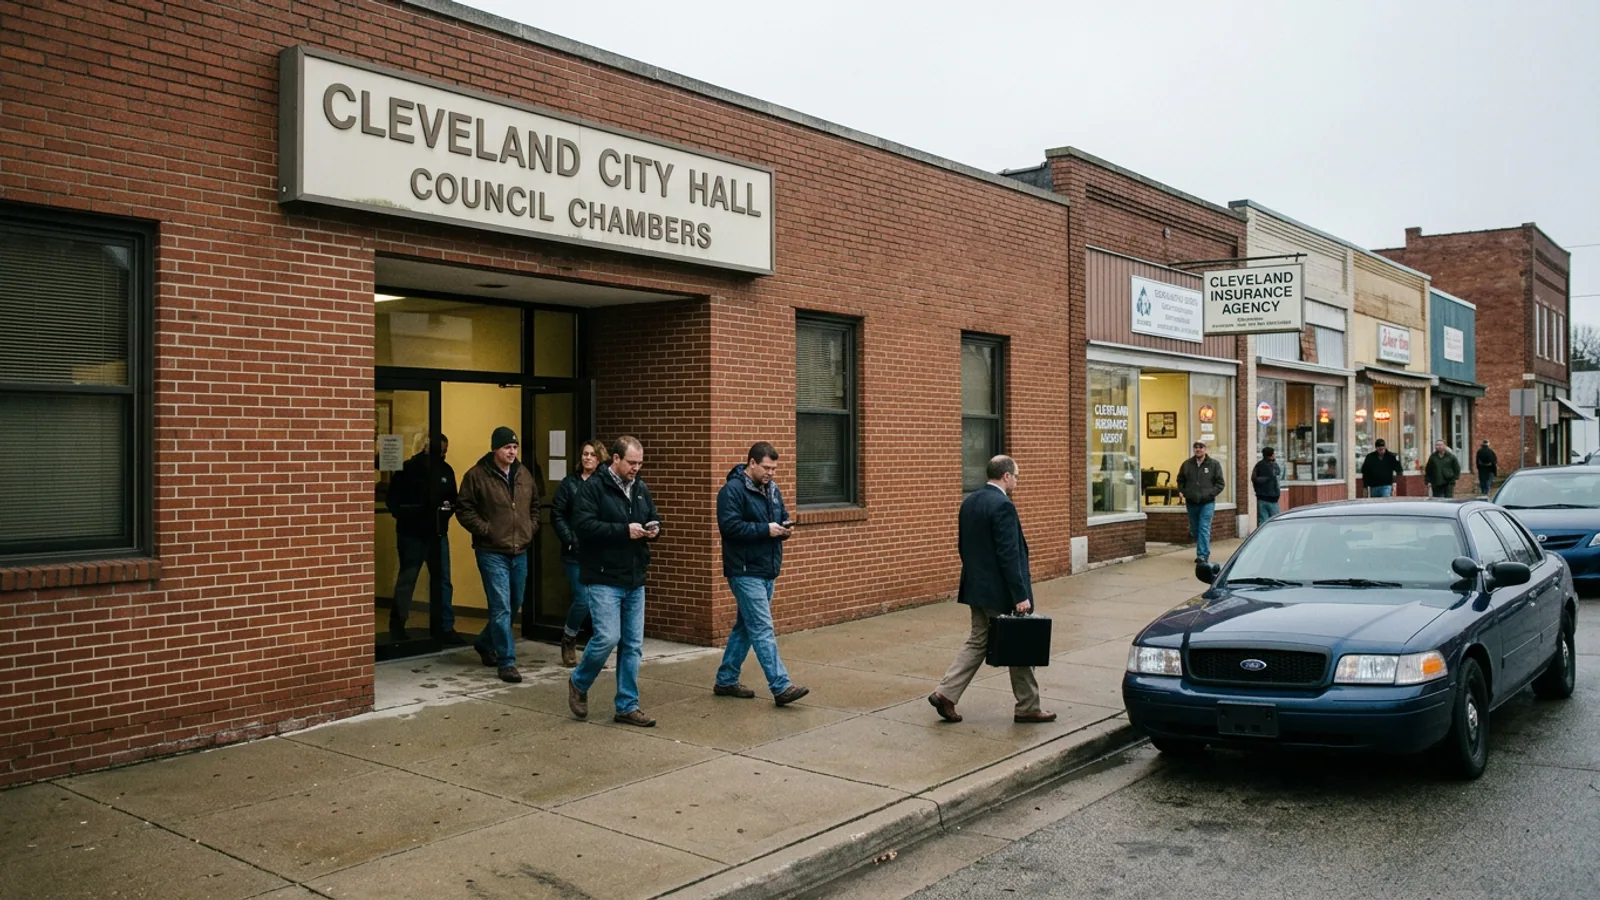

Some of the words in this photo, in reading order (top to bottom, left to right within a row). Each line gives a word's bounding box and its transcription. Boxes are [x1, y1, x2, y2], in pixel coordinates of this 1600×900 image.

[323, 83, 581, 177] CLEVELAND
[598, 148, 675, 198] CITY
[689, 169, 762, 217] HALL
[410, 167, 555, 222] COUNCIL
[568, 197, 712, 250] CHAMBERS
[1210, 271, 1294, 288] CLEVELAND
[1210, 286, 1293, 301] INSURANCE
[1222, 300, 1280, 315] AGENCY
